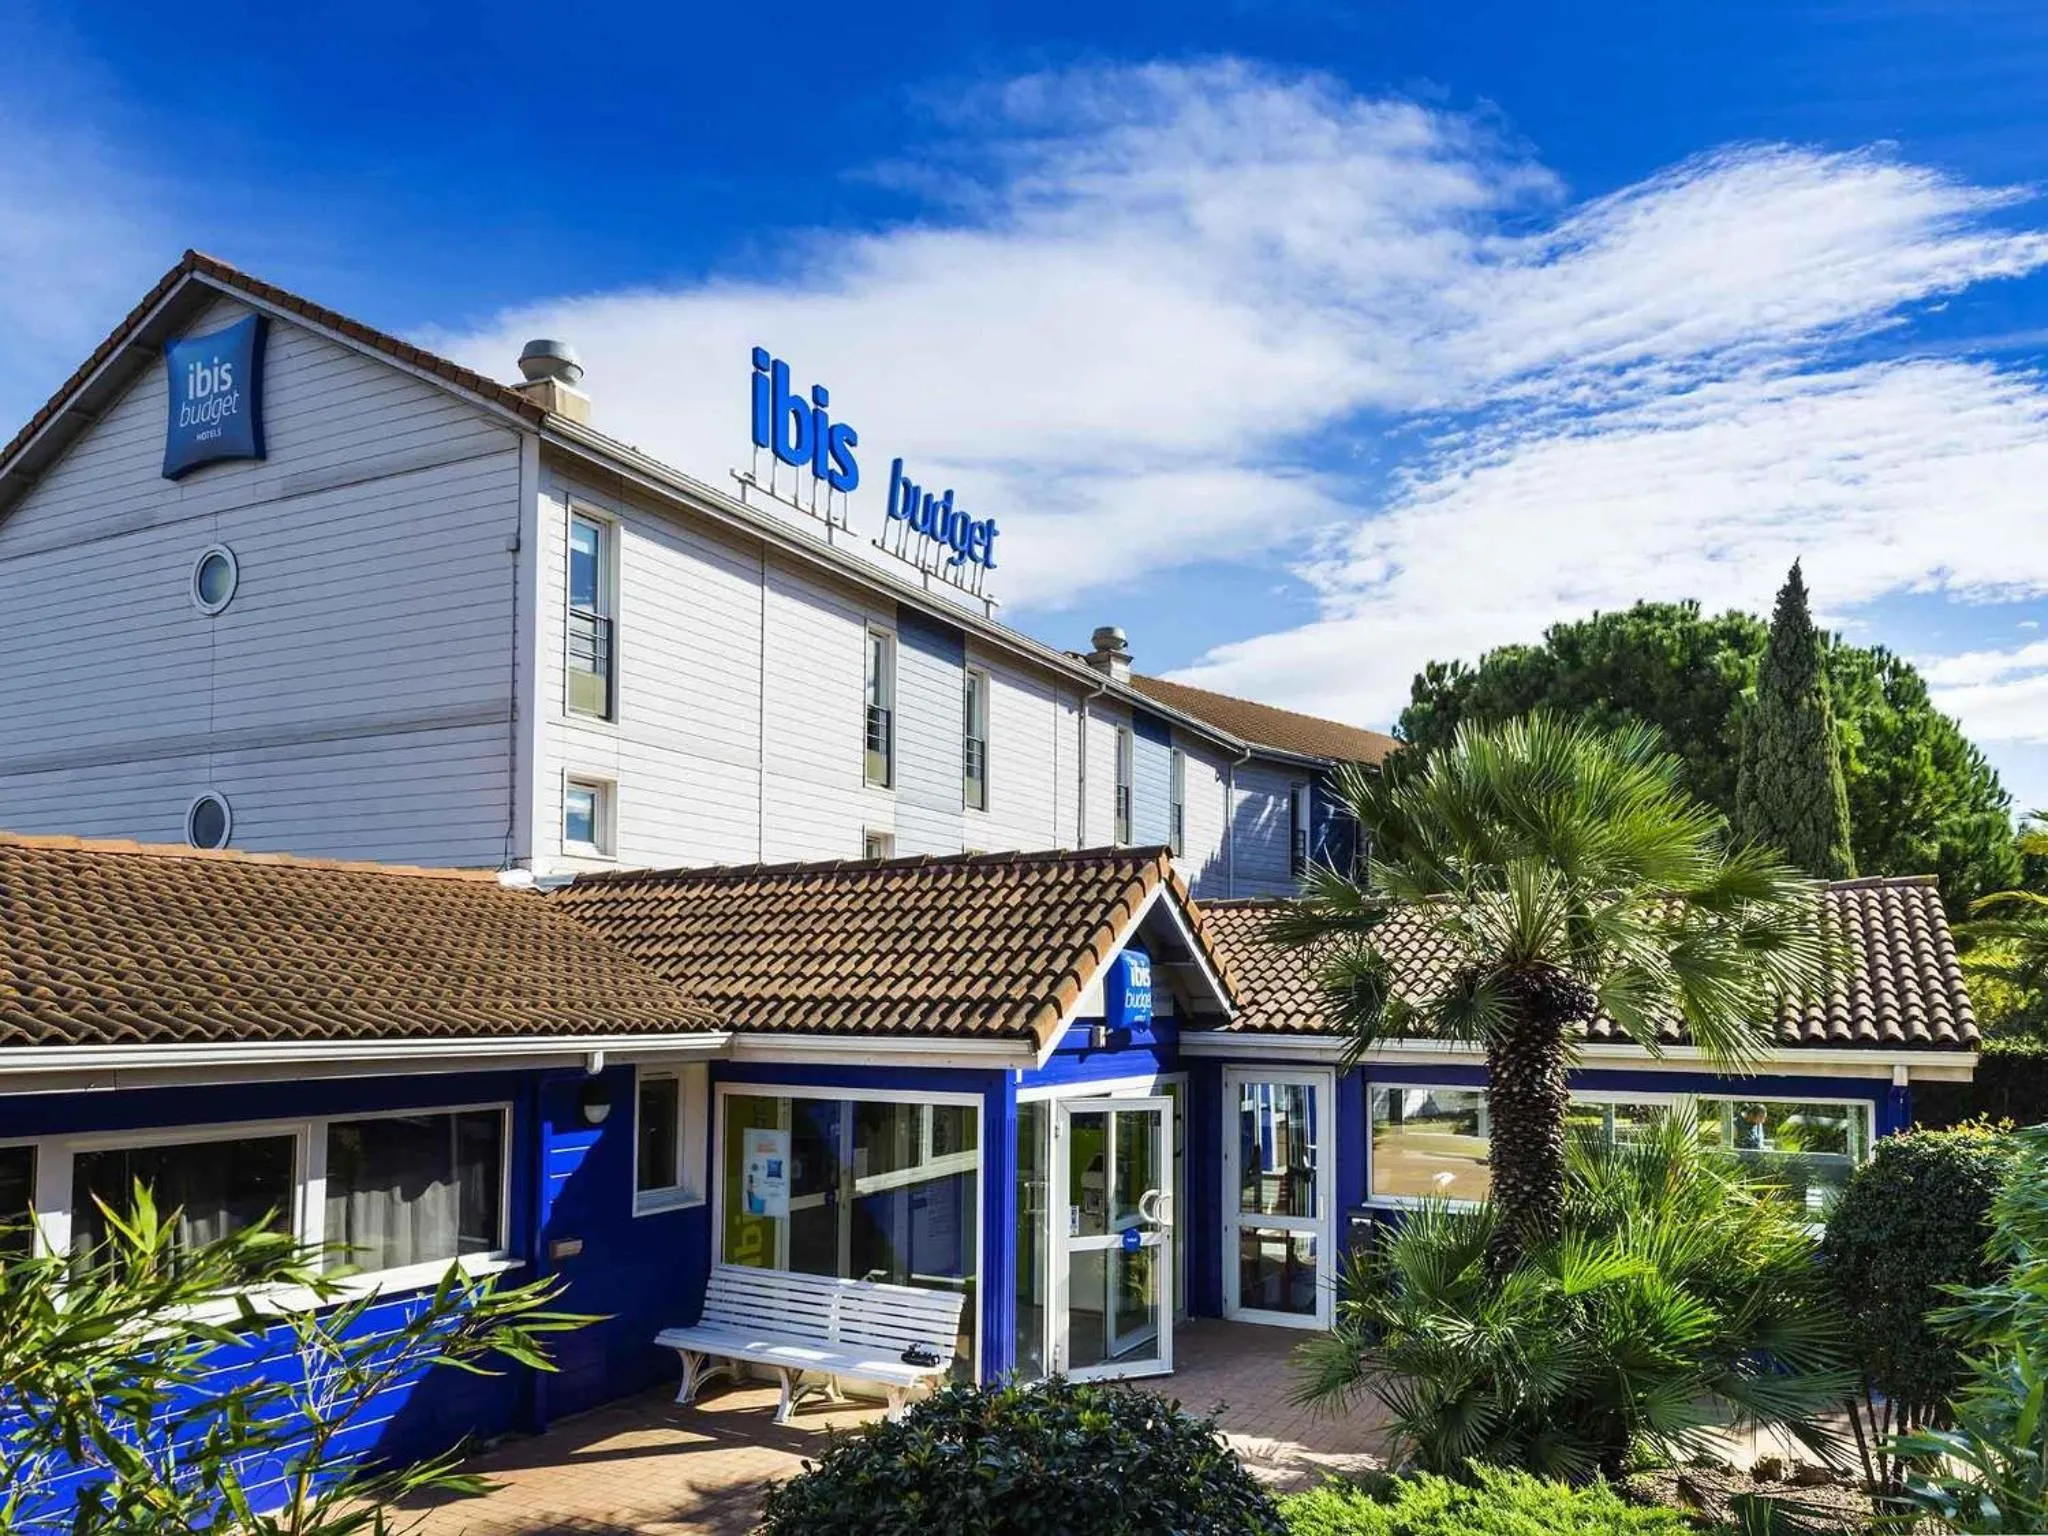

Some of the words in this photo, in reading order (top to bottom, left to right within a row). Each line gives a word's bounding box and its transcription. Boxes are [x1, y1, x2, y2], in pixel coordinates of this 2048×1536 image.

[188, 356, 233, 400] ibis
[179, 389, 240, 428] budget
[752, 346, 859, 493] ibis
[888, 457, 999, 569] budget
[1129, 957, 1152, 988] ibis
